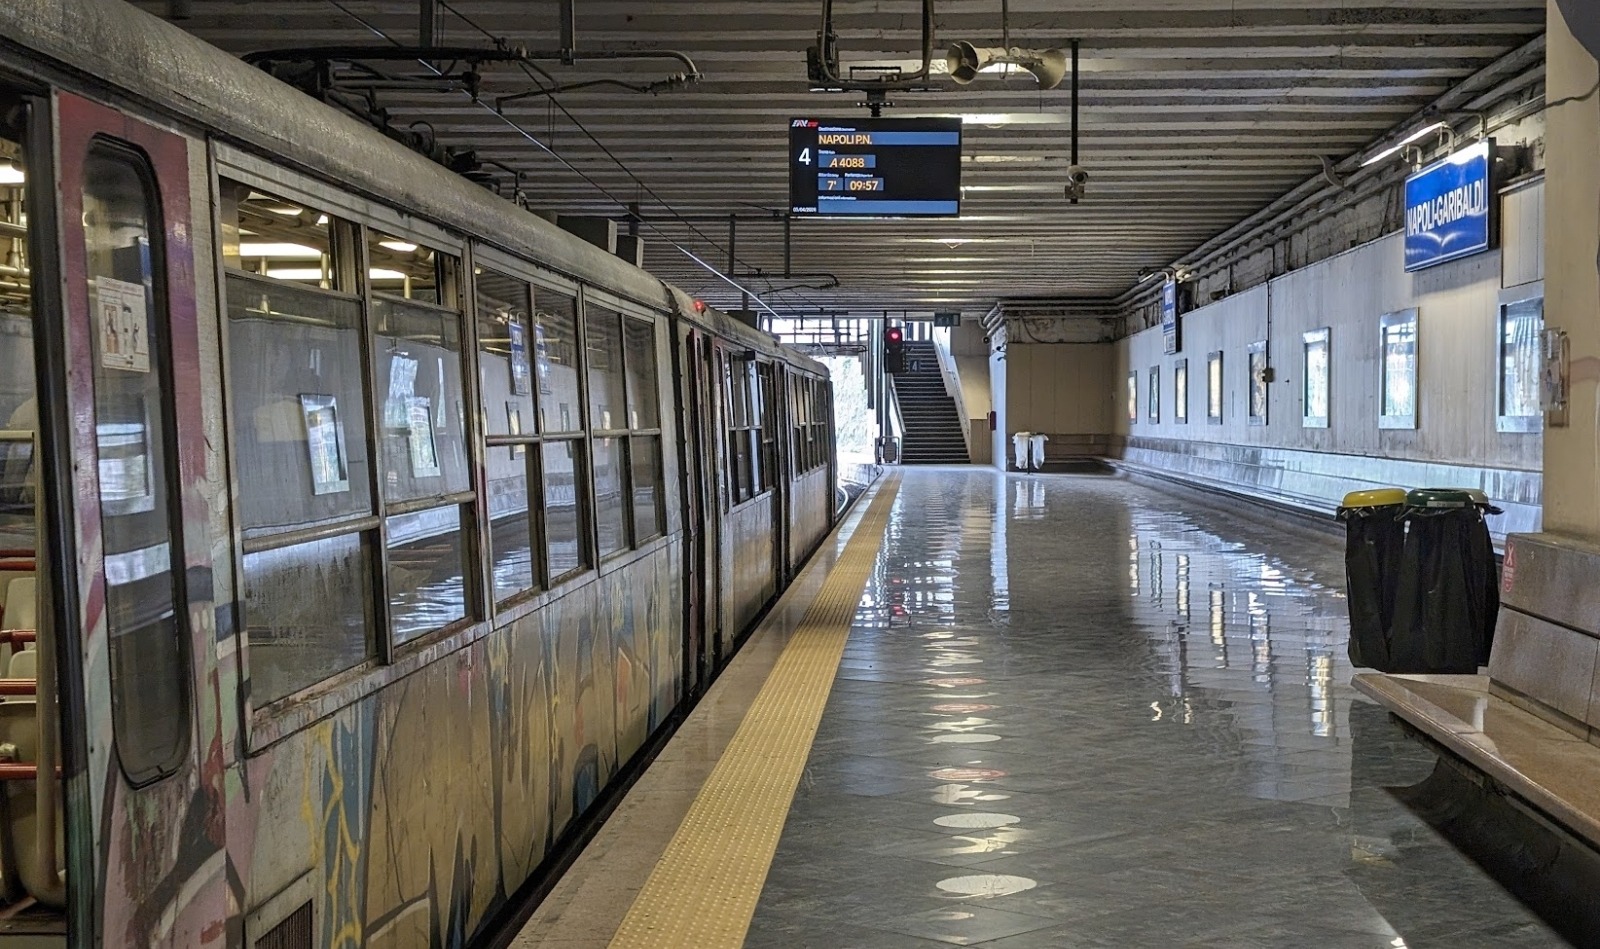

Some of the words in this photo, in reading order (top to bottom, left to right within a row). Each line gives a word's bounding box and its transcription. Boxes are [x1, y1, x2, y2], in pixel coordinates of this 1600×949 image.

[818, 134, 854, 145] NAPOLI
[855, 134, 873, 145] P.N.
[798, 147, 811, 165] 4
[829, 157, 838, 168] A
[839, 157, 865, 168] 4088
[849, 180, 879, 191] 09:57
[1407, 178, 1484, 237] NAPOLI-GARIBALDI
